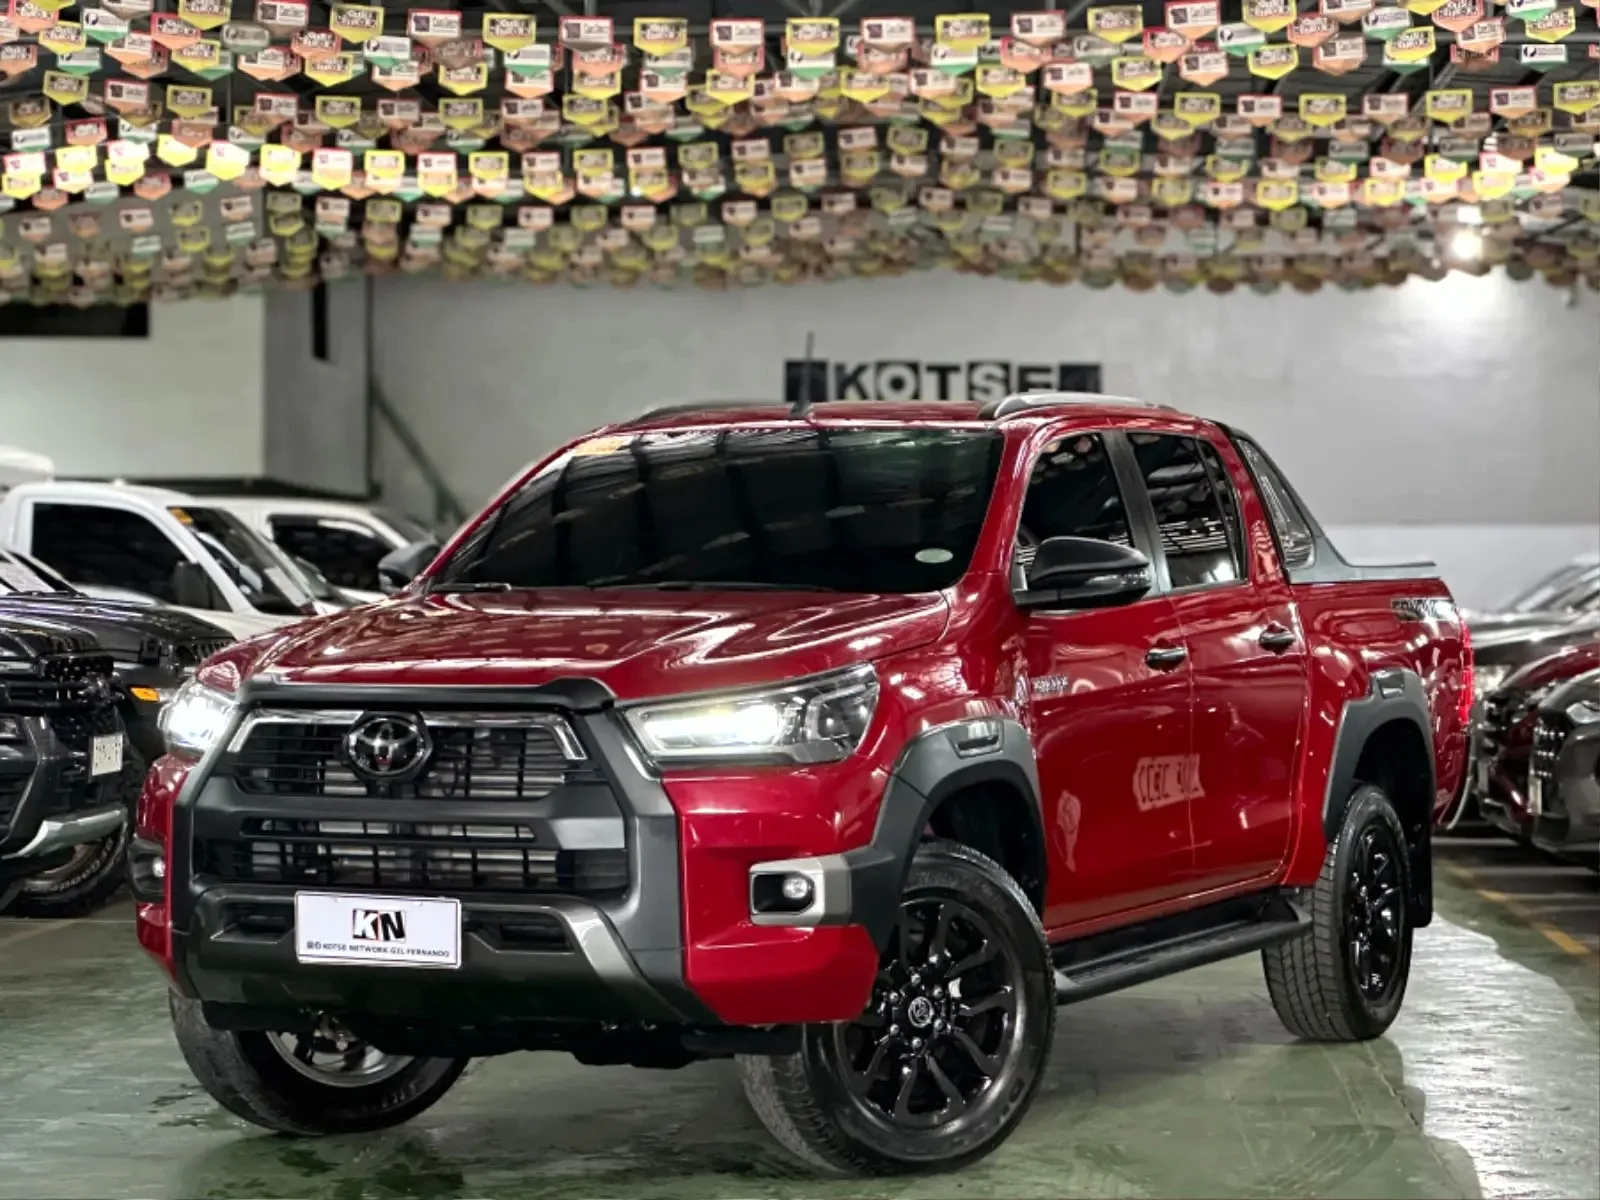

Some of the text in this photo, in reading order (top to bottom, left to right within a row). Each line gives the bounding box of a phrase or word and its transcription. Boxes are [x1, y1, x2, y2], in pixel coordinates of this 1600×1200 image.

[834, 360, 1056, 402] KOTSE
[353, 909, 406, 942] KN
[322, 943, 347, 951] KOTSE
[349, 944, 388, 953] NETWORK
[406, 948, 450, 957] FERNANDO
